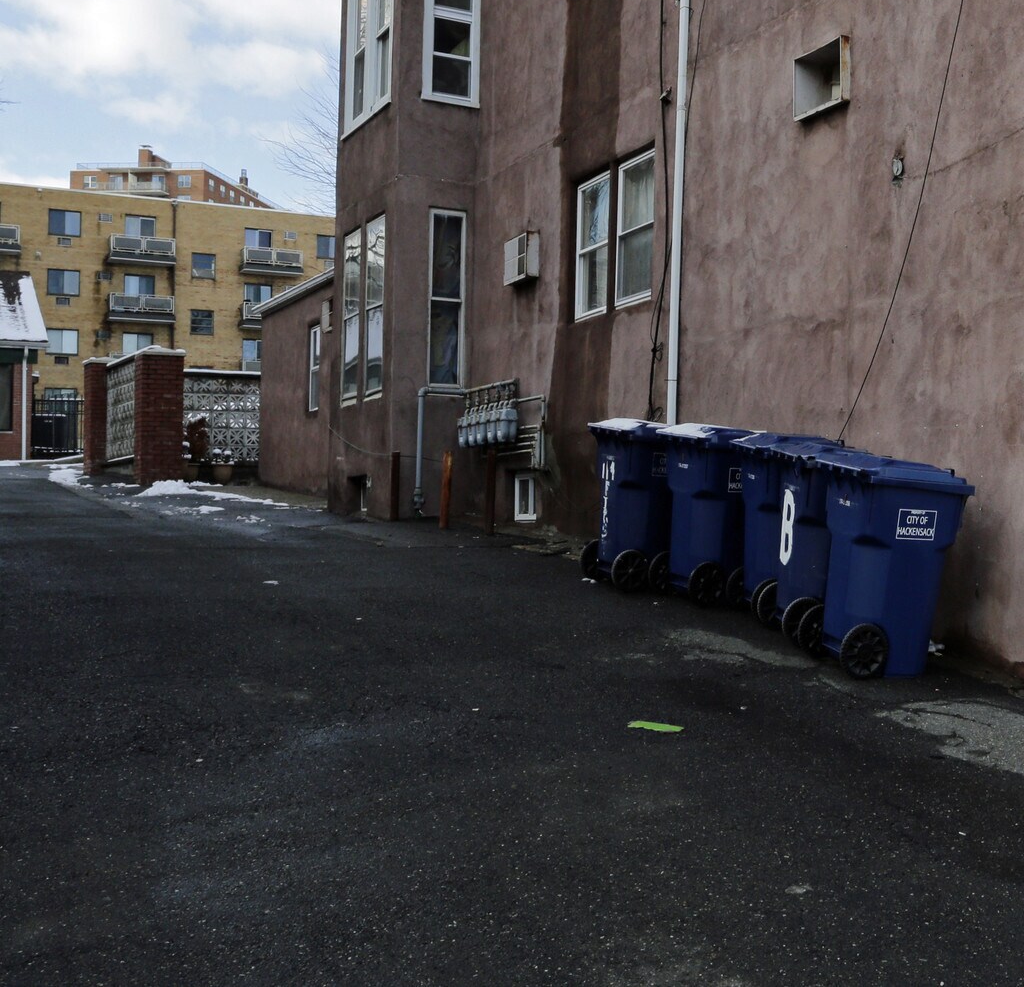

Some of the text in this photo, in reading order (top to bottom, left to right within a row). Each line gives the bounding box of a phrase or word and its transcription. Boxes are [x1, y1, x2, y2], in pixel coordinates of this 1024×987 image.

[906, 515, 929, 525] CITY OF
[779, 489, 796, 566] B
[897, 527, 934, 537] HACKENSACK
